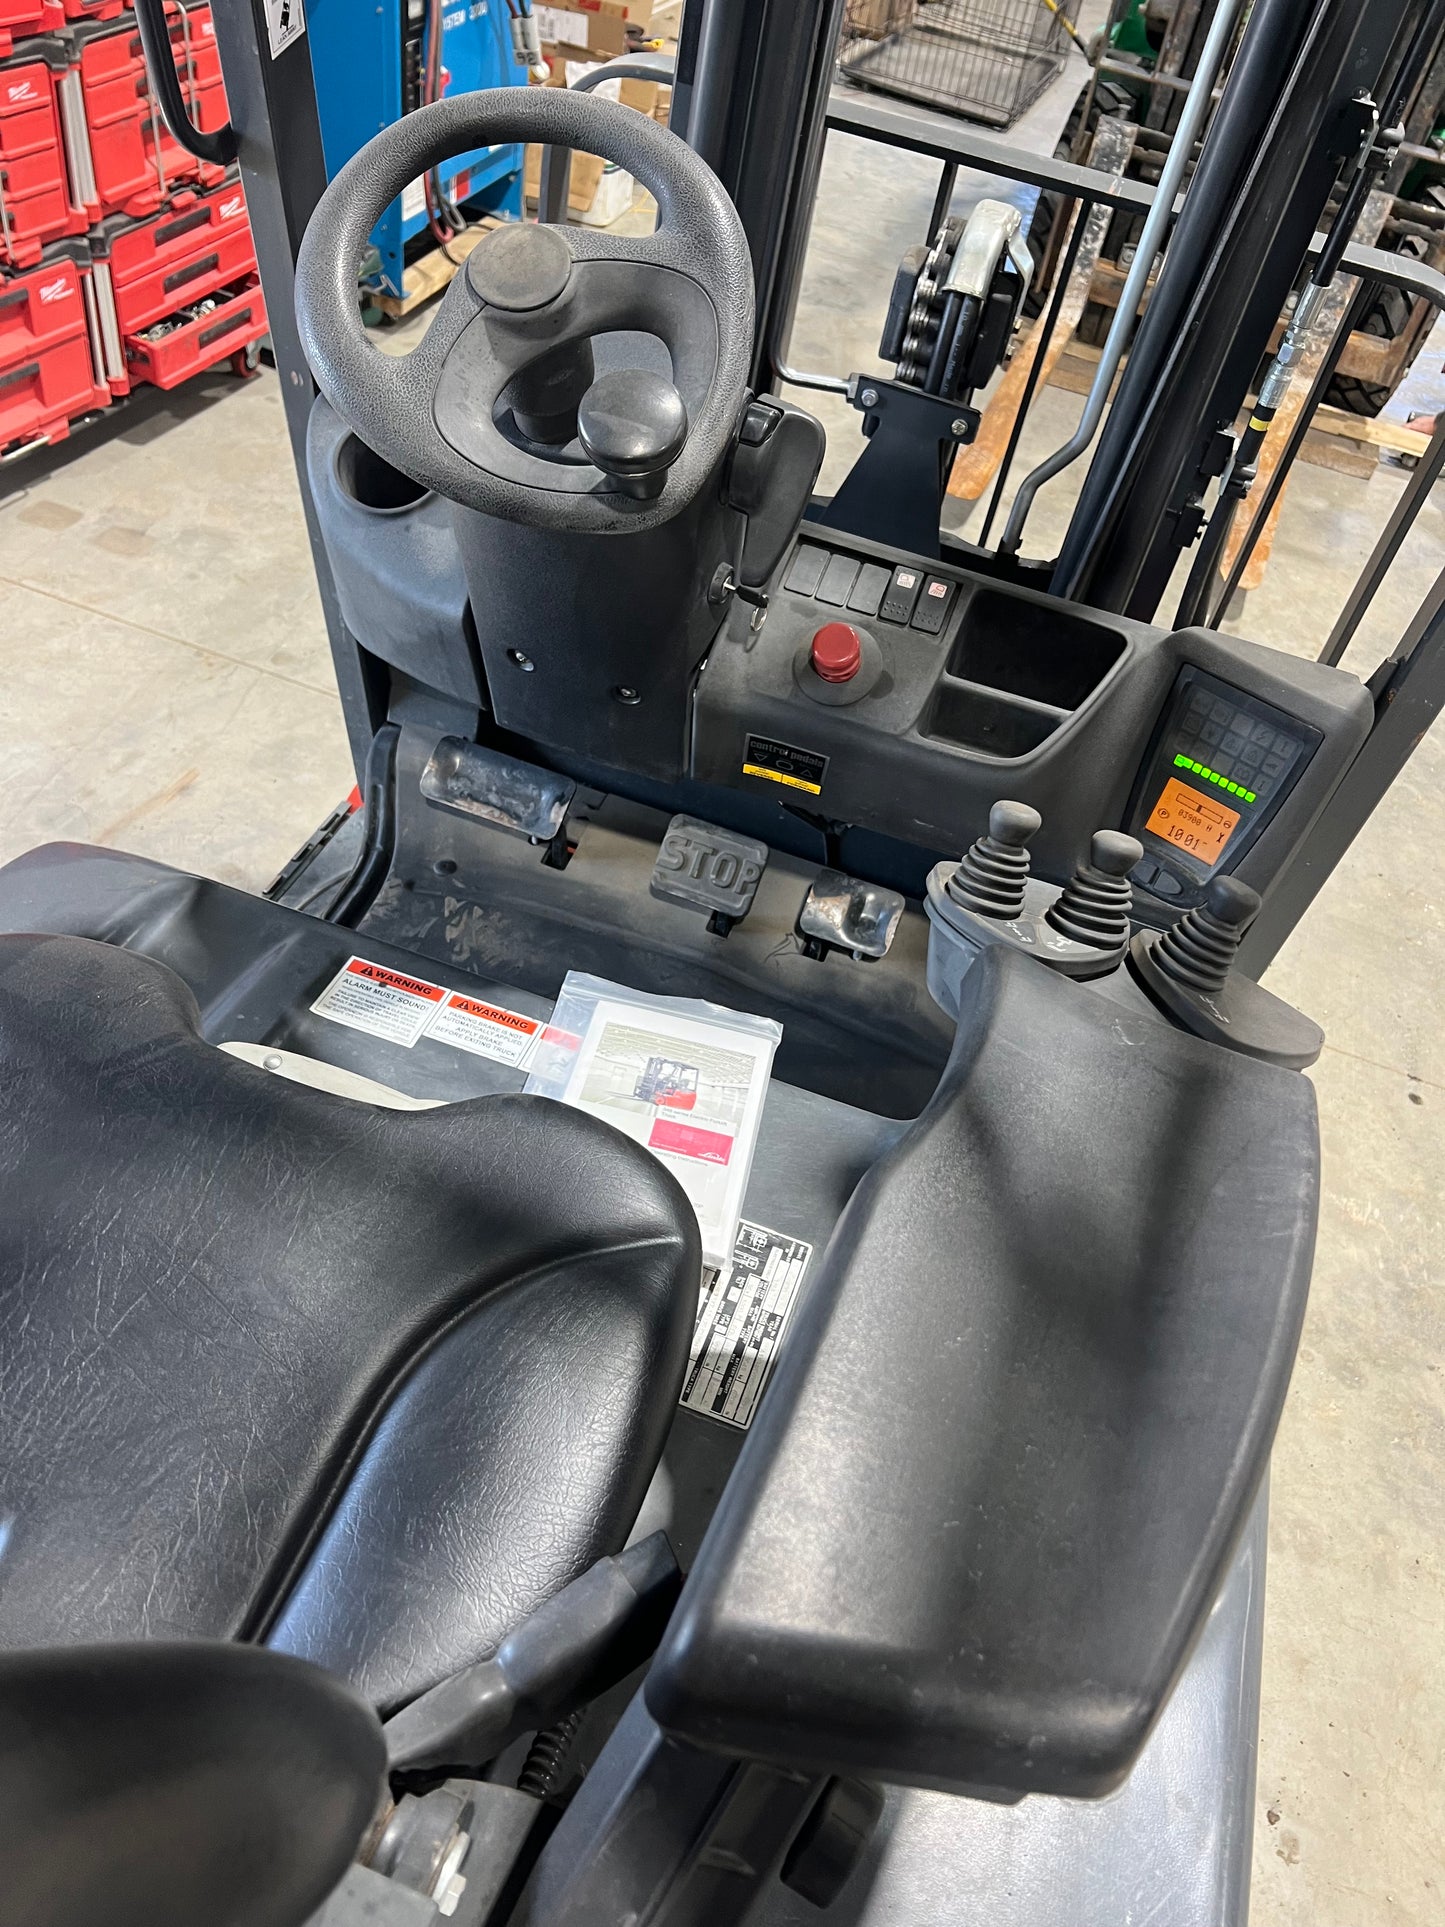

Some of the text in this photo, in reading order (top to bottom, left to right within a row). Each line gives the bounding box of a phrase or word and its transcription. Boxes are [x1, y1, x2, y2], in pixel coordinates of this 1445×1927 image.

[656, 834, 761, 895] STOP
[343, 978, 373, 992] ALARM
[373, 988, 395, 1001] MUST
[375, 970, 432, 995] WARNING
[442, 1015, 496, 1037] AUTOMATICALLY
[449, 1011, 523, 1040] PARKING BRAKE IS NOT
[472, 1004, 529, 1029] WARNING
[434, 1025, 516, 1057] BEFORE EXITING TRUCK
[456, 1026, 503, 1046] APPLY BRAKE
